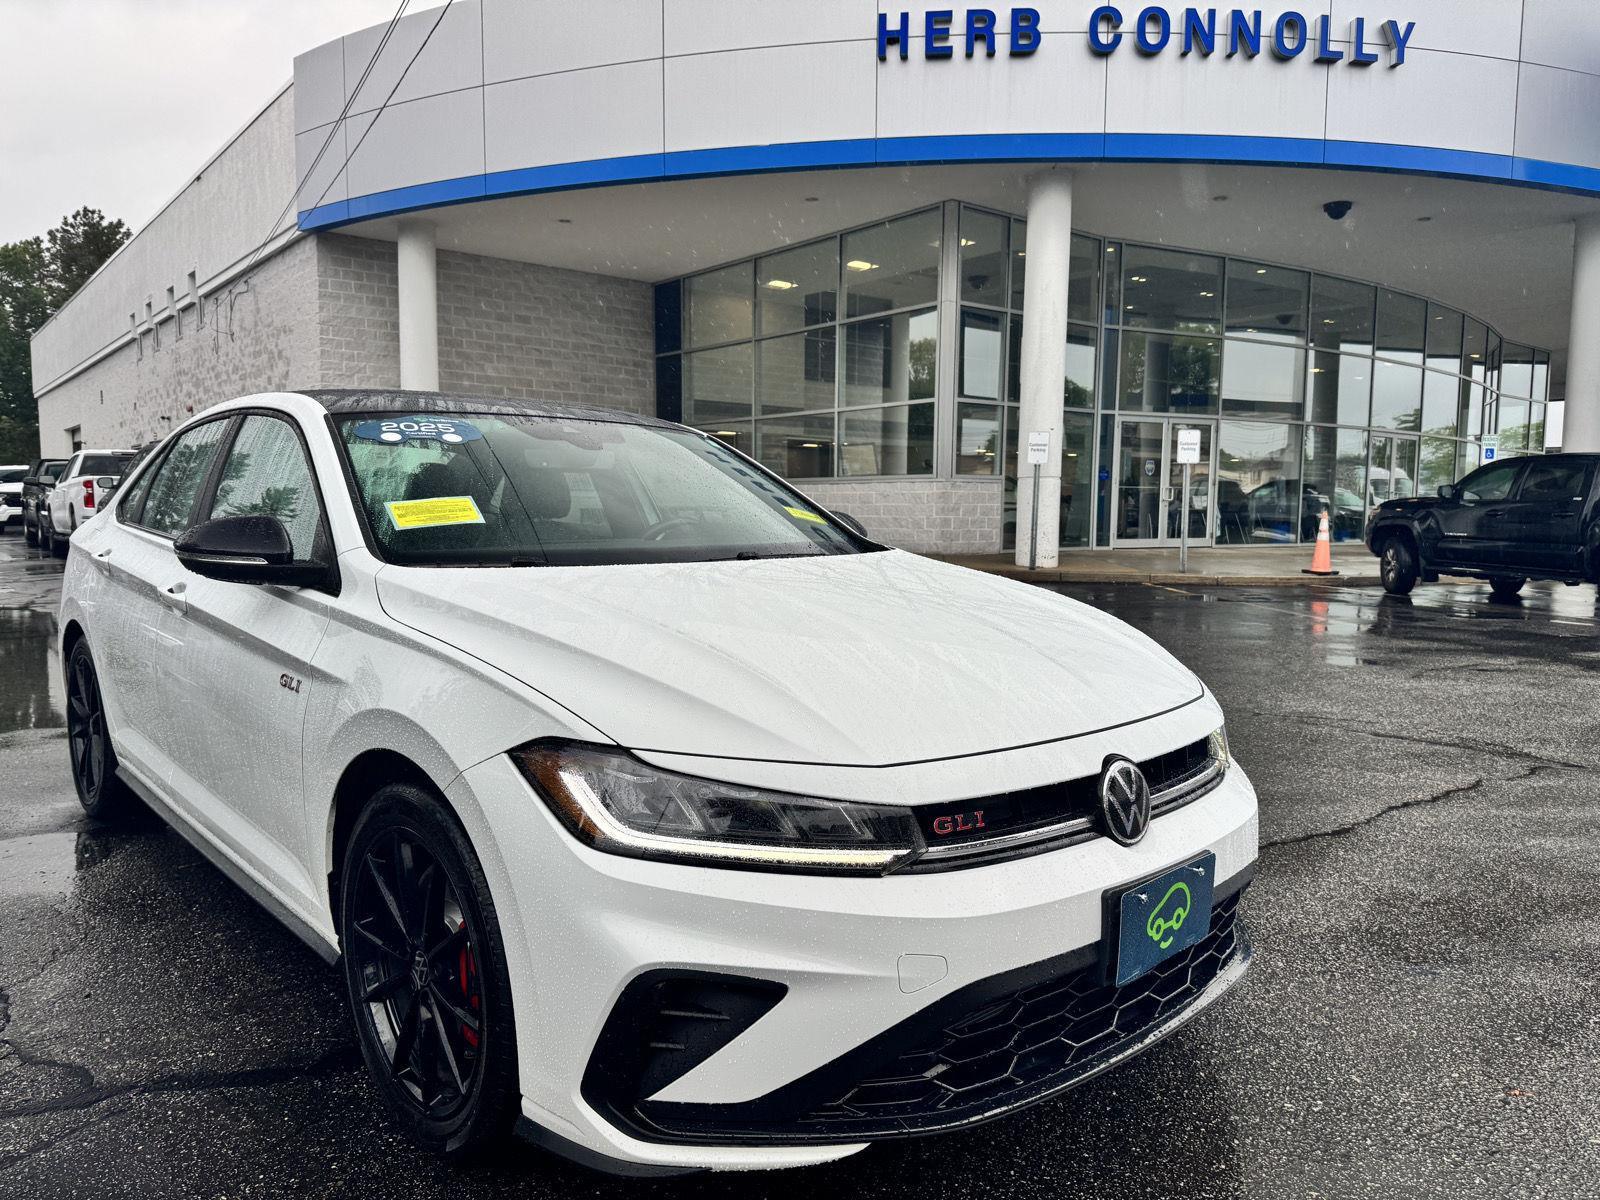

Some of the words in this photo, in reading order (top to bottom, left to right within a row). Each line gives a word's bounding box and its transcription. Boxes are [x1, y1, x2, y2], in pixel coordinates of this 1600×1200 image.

[877, 7, 1041, 60] HERB
[1087, 6, 1416, 68] CONNOLLY
[380, 422, 456, 433] 2025
[280, 673, 302, 693] GLI
[933, 810, 985, 834] GLI
